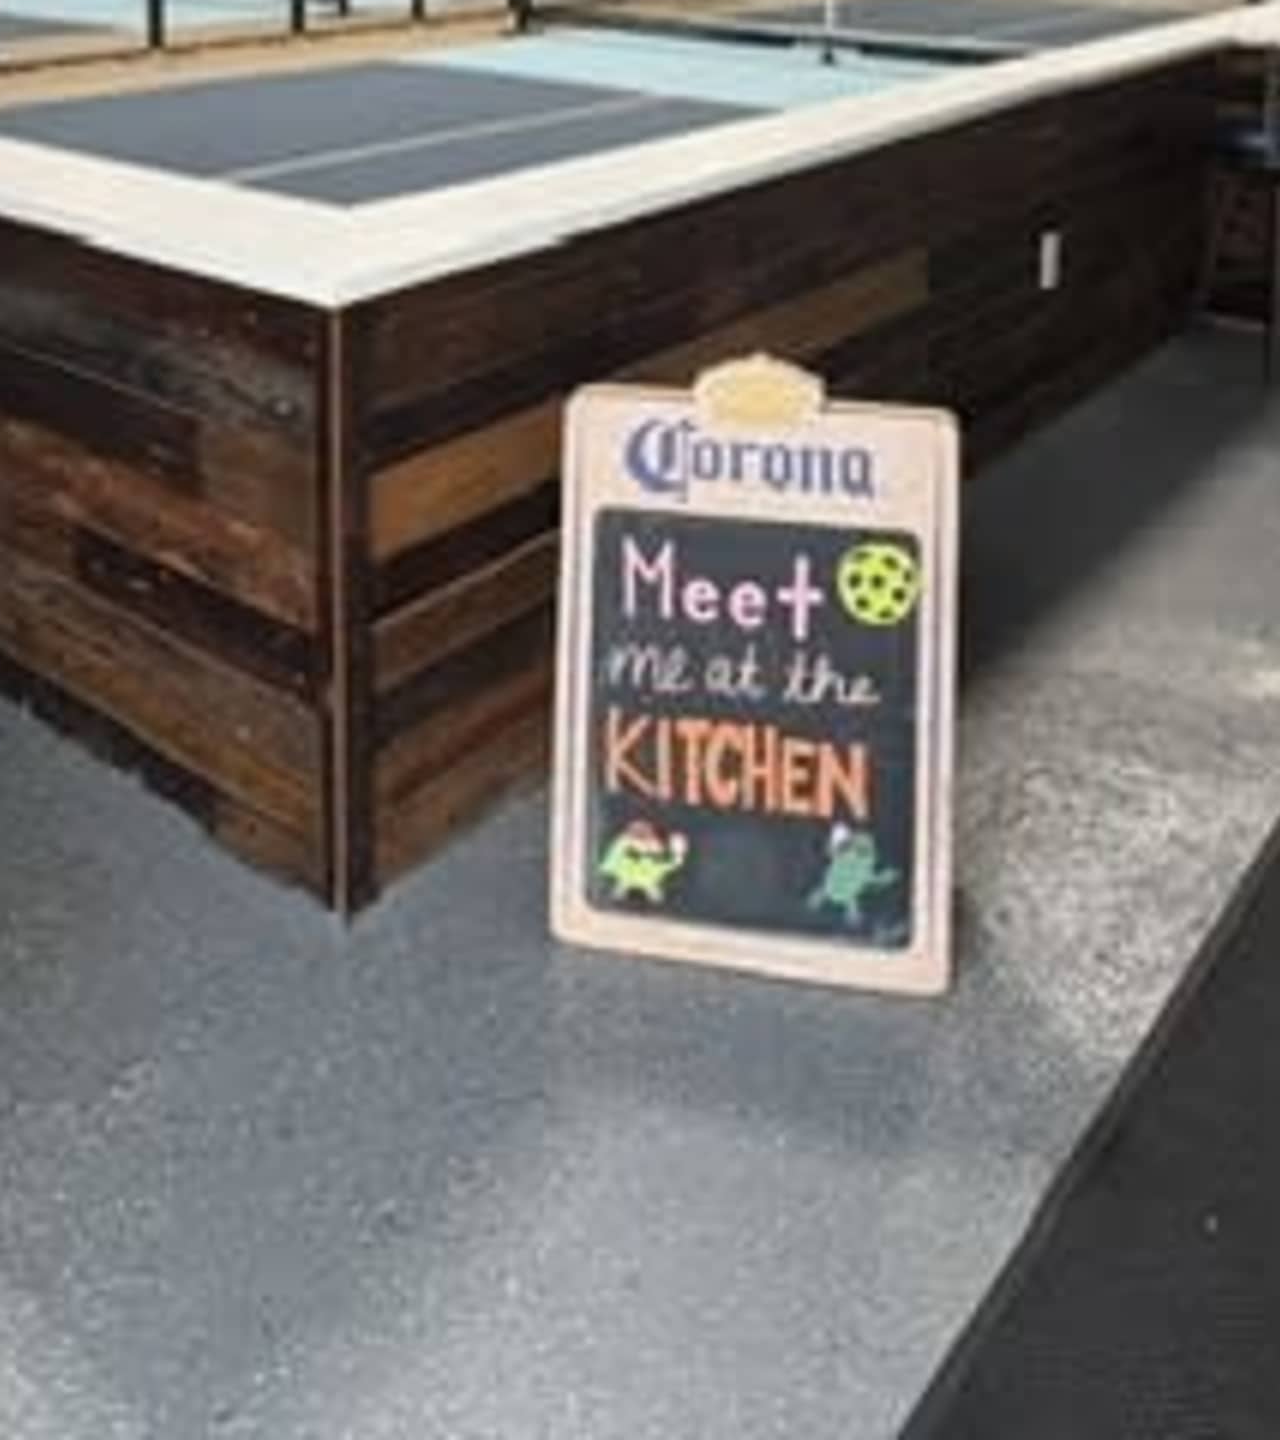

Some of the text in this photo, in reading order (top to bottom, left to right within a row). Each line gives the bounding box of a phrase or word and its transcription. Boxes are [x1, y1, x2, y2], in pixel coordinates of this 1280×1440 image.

[624, 418, 876, 502] Corona
[621, 534, 823, 639] Meet
[704, 642, 765, 699] at
[783, 647, 882, 703] the
[604, 705, 870, 820] KITCHEN
